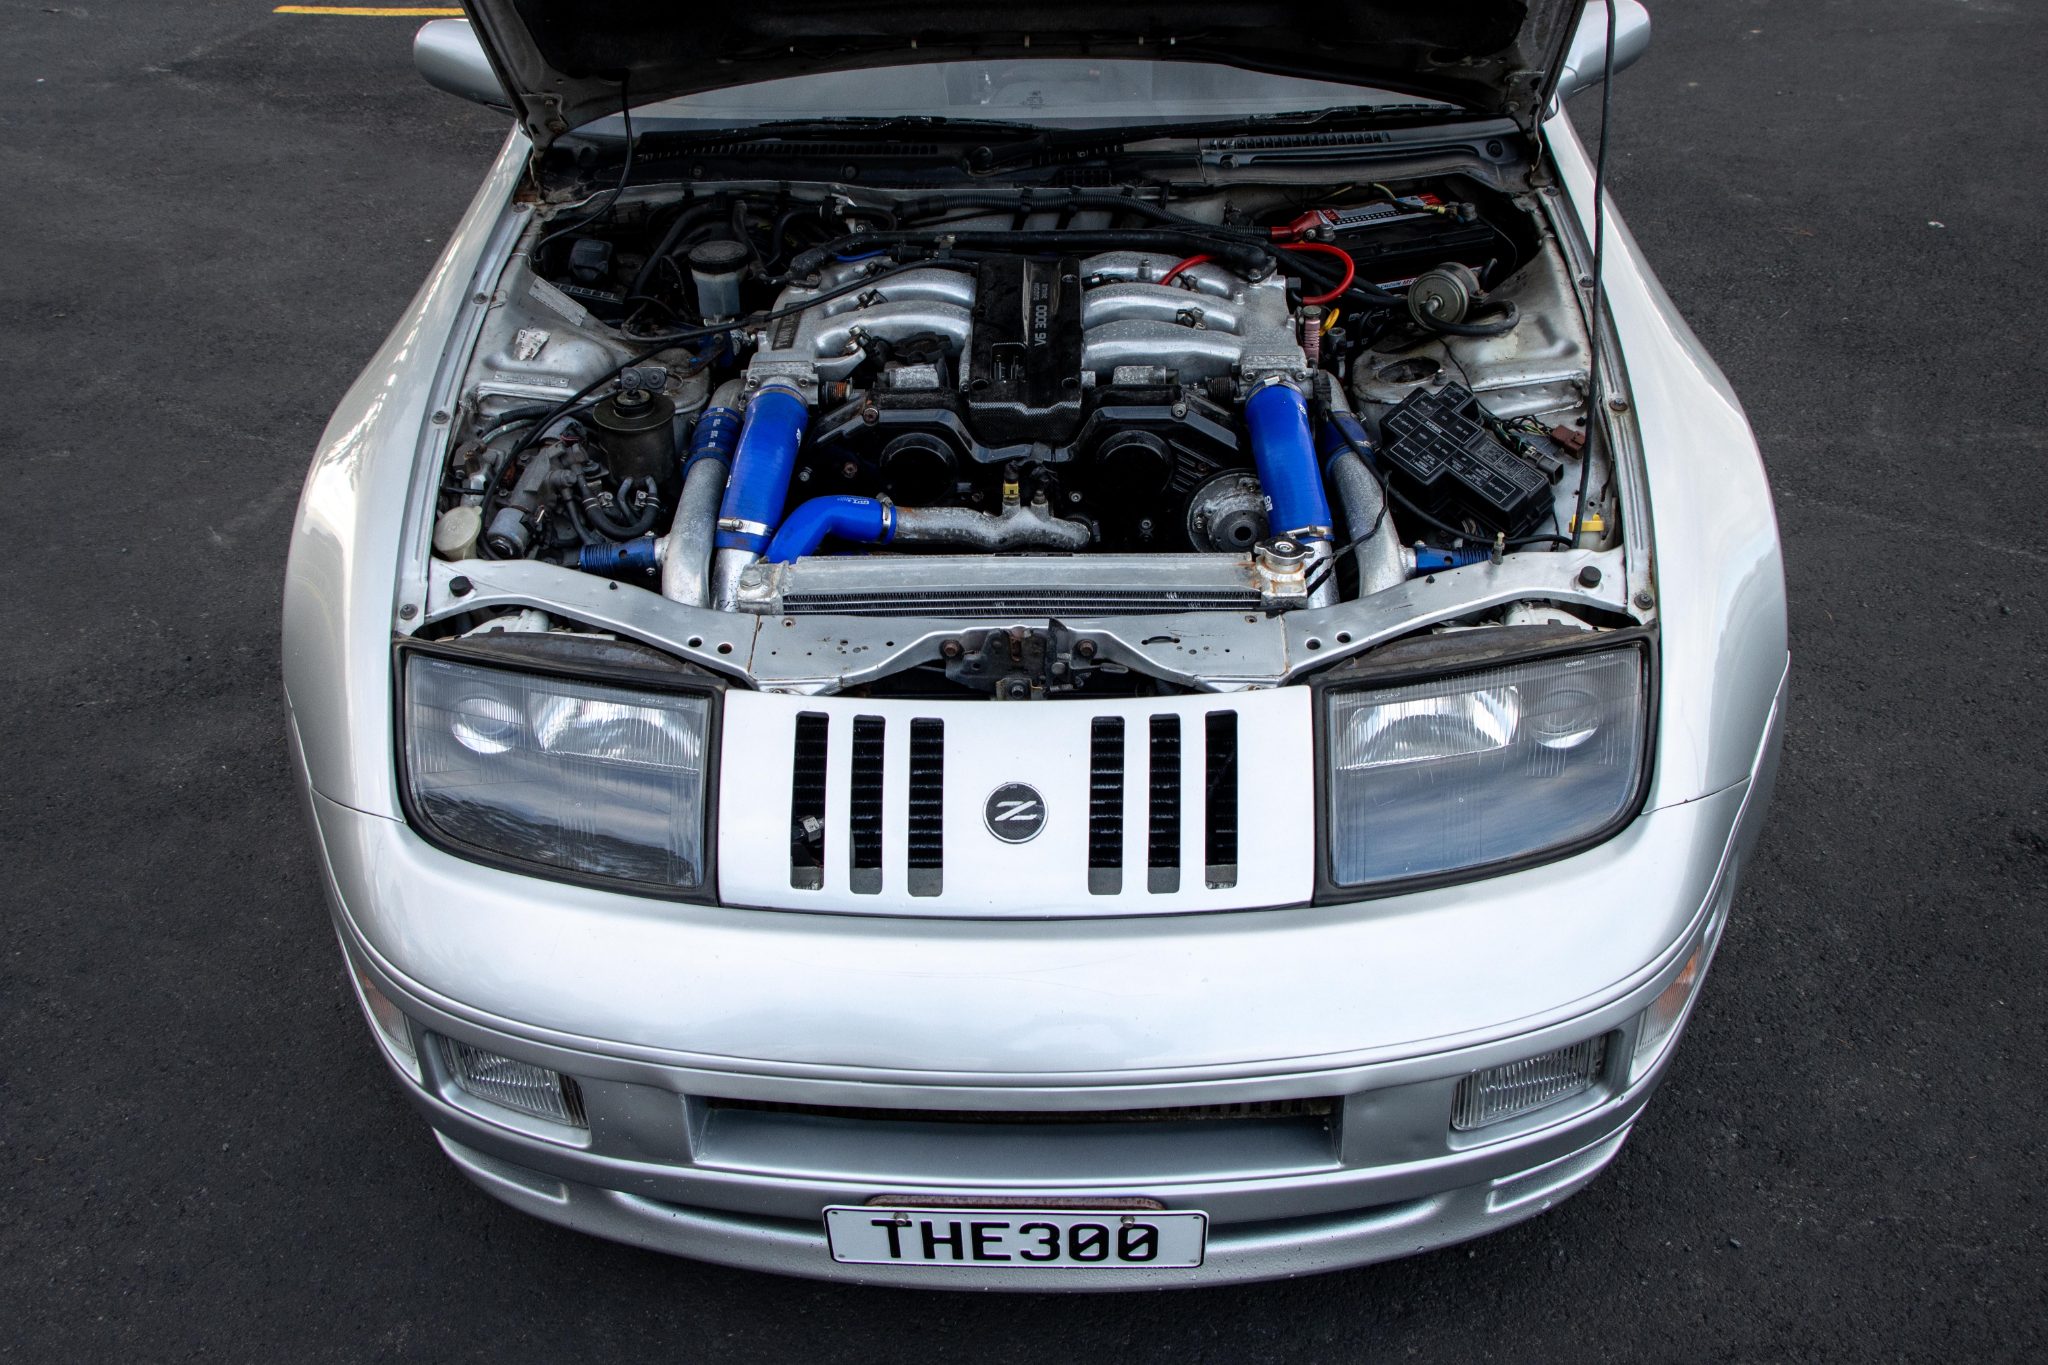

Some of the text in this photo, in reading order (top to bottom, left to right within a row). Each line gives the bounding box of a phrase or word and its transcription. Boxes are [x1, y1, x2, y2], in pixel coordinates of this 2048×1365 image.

[1035, 304, 1048, 329] 3000
[1034, 333, 1047, 347] V6
[994, 800, 1037, 821] Z
[871, 1219, 1159, 1262] THE300
